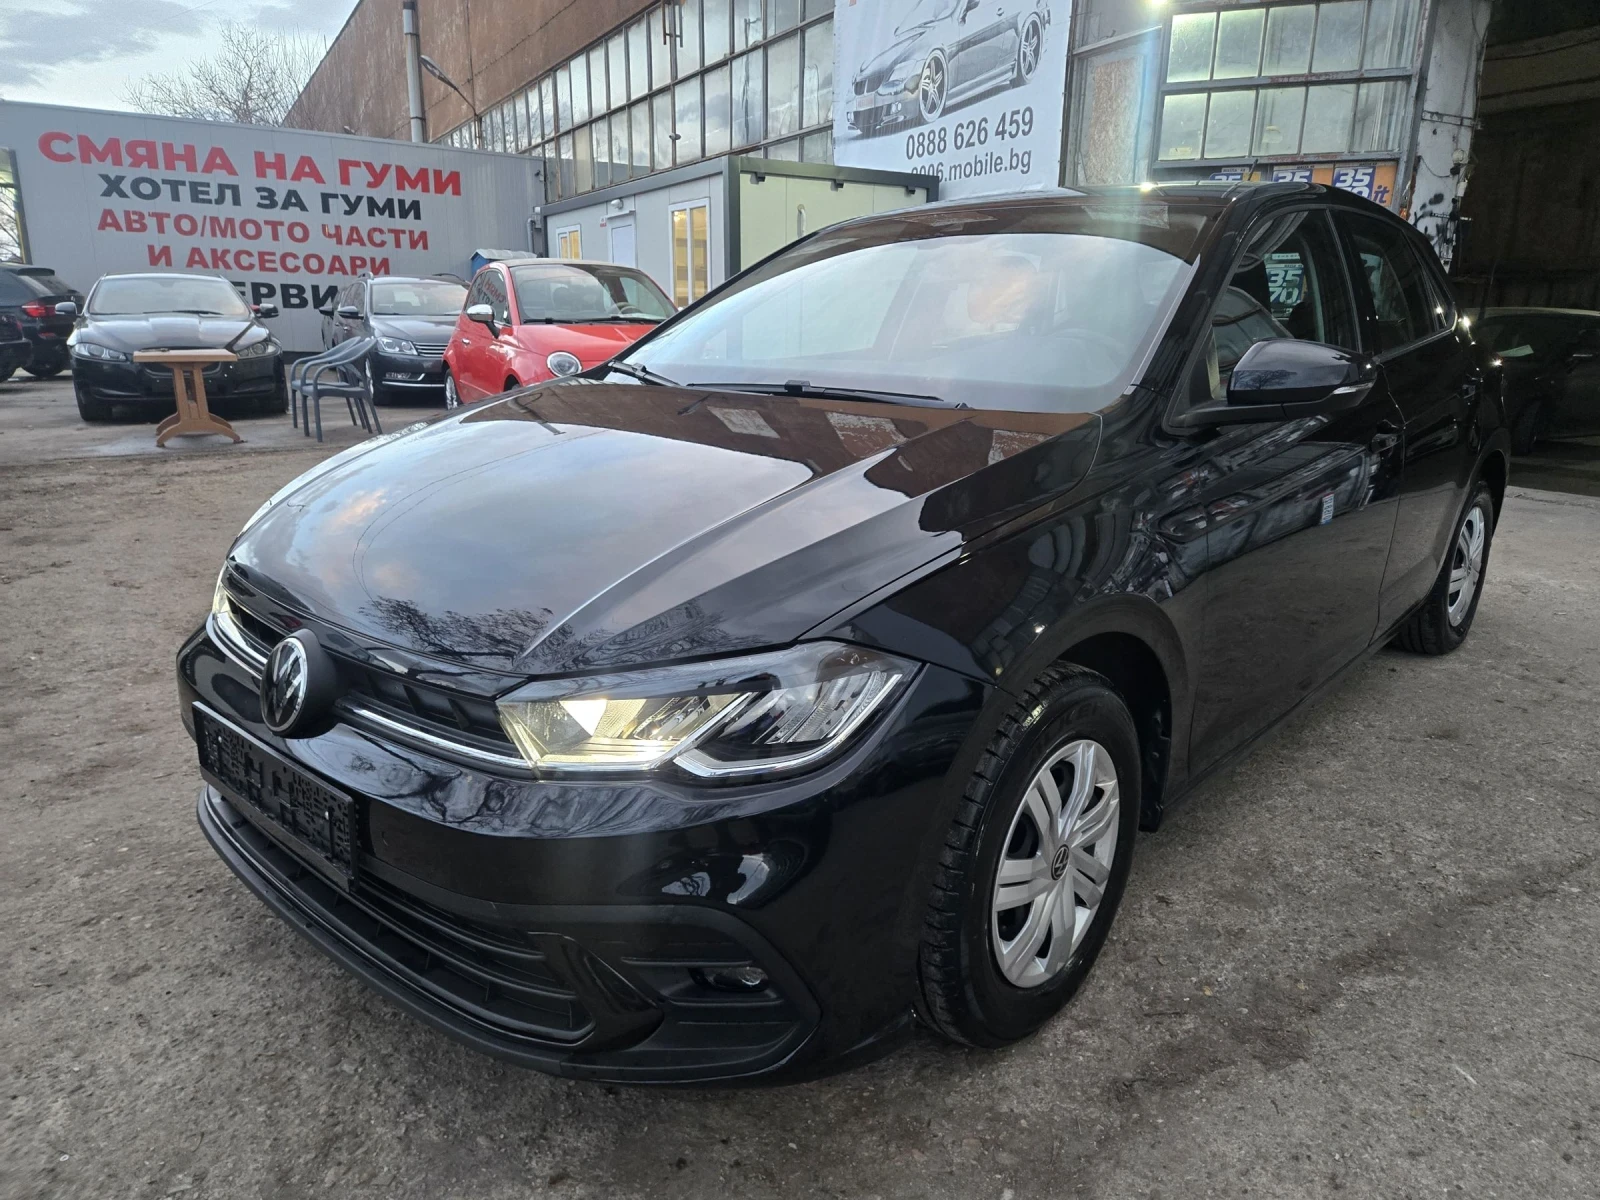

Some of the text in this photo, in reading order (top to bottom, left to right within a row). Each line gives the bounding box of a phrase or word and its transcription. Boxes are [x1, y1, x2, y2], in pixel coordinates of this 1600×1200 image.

[906, 106, 1034, 160] 0888 626 459
[38, 132, 462, 196] СМЯНА НА ГУМИ
[1335, 168, 1373, 187] 35
[99, 174, 422, 220] ХОТЕЛ ЗА ГУМИ
[1373, 185, 1389, 204] it
[97, 208, 429, 250] АВТО/МОТО ЧАСТИ
[148, 244, 390, 276] И АКСЕСОАРИ
